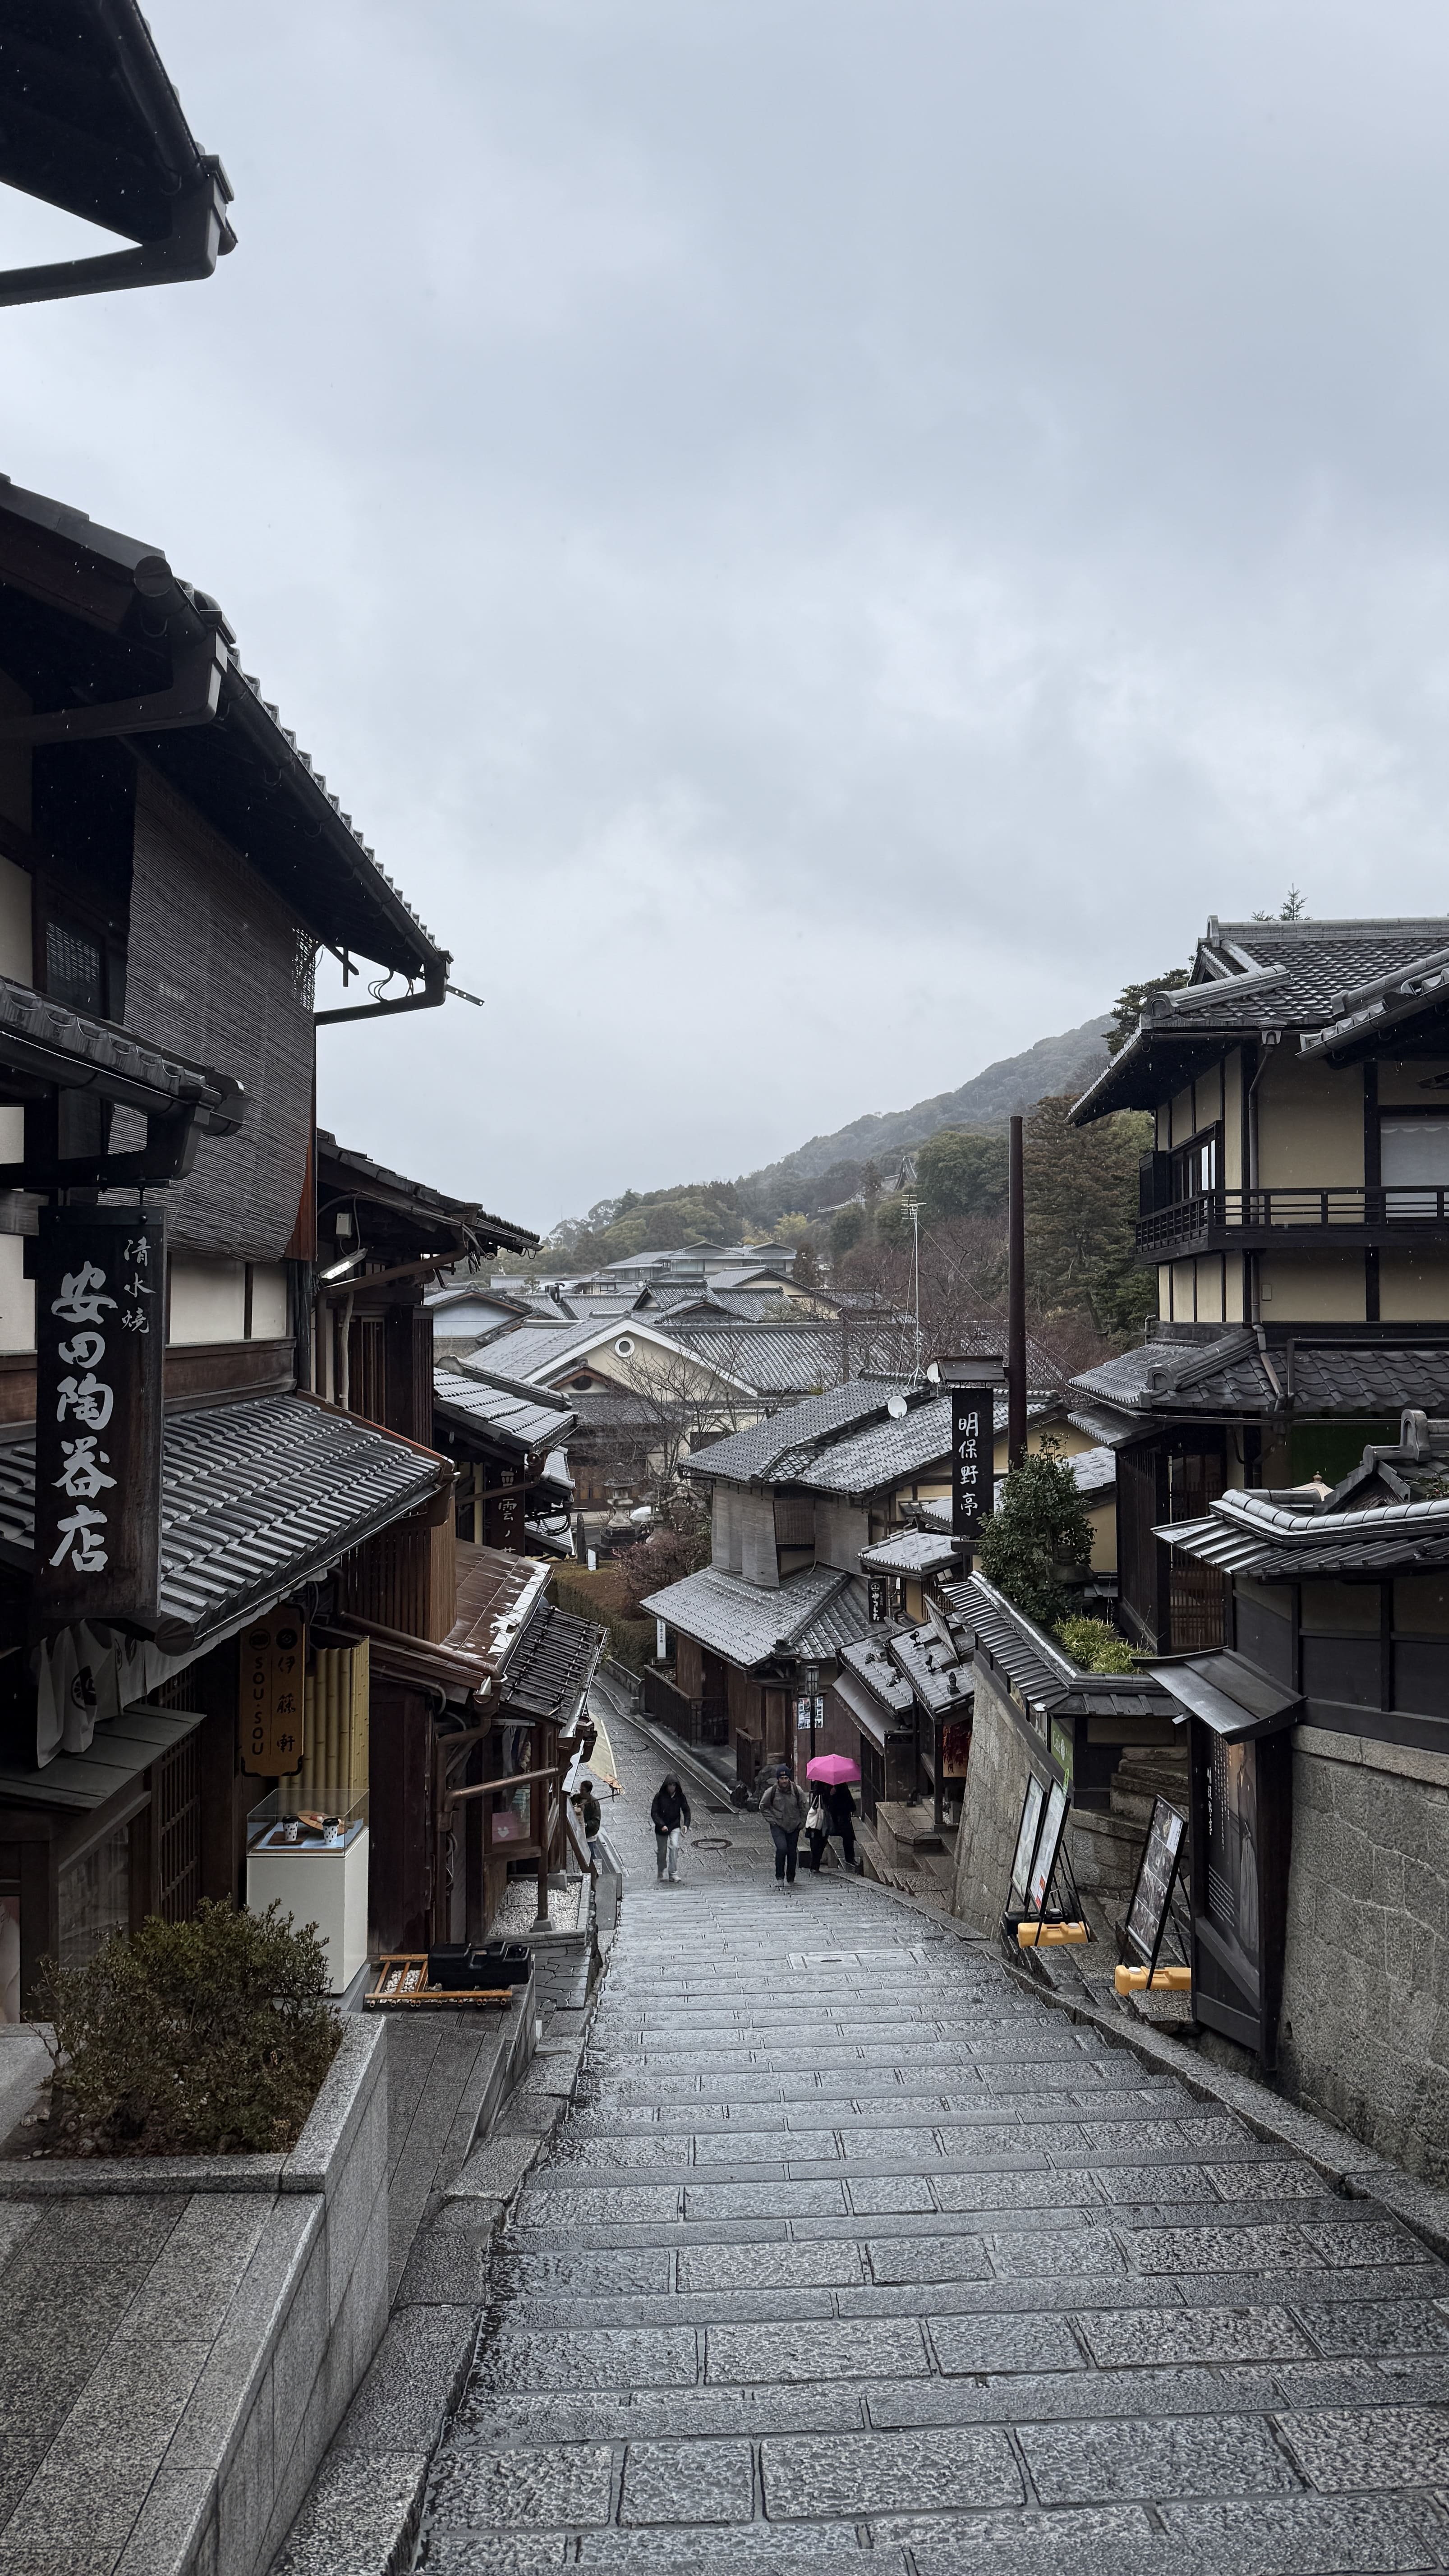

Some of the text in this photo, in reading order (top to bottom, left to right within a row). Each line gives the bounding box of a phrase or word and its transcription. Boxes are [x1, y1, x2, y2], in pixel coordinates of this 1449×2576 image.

[49, 1260, 118, 1572] 安田陶器店
[958, 1412, 979, 1516] 明保野亭
